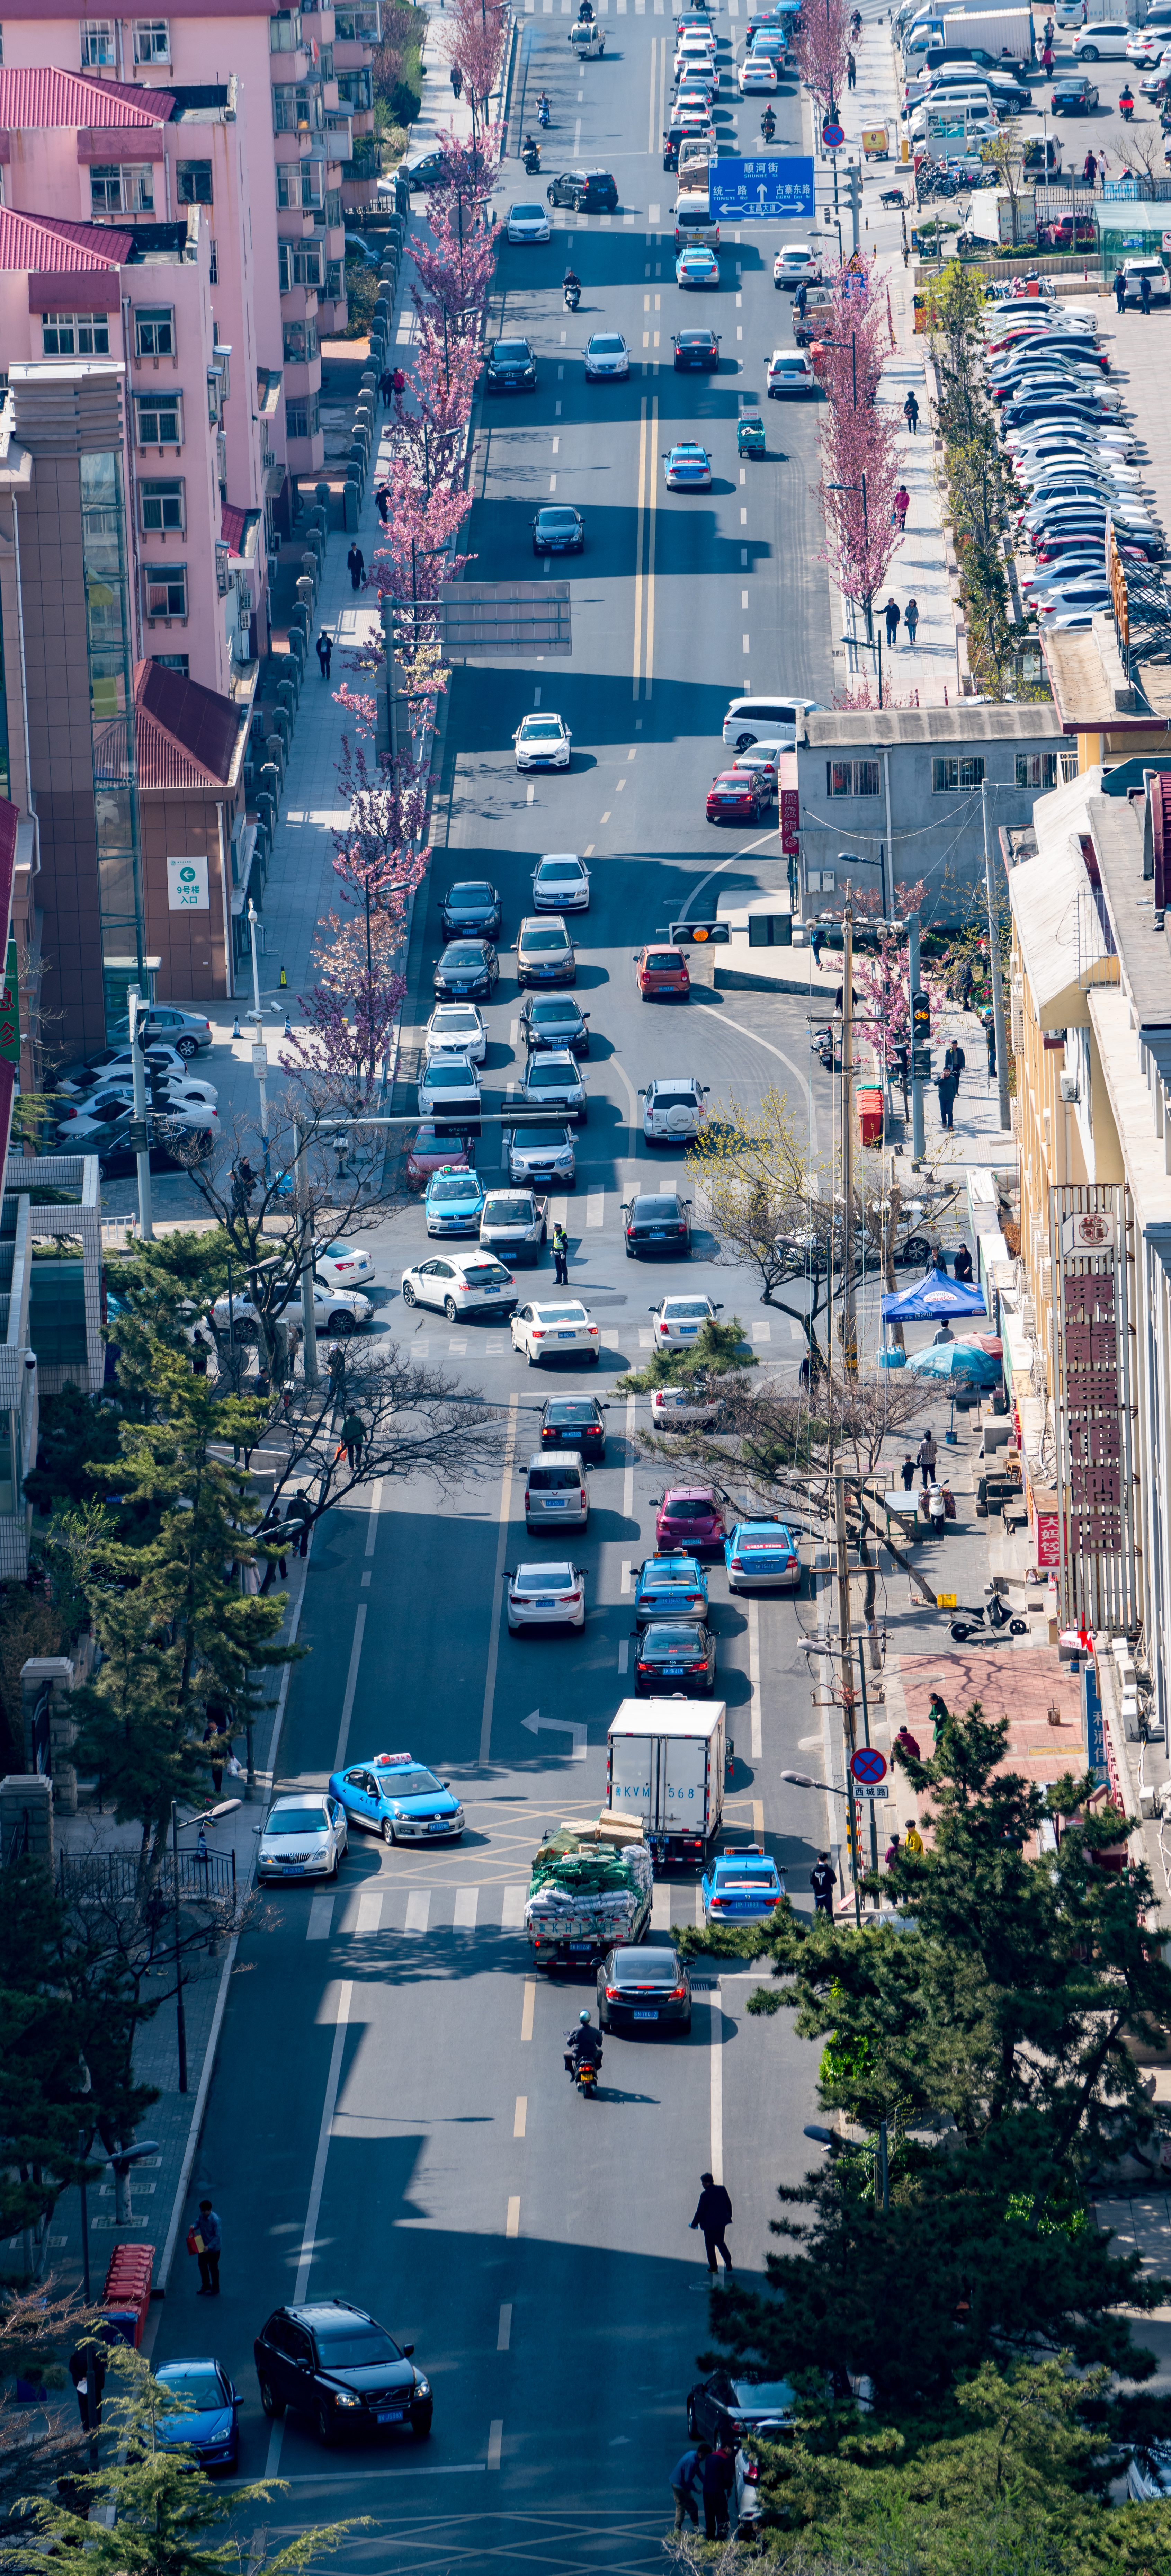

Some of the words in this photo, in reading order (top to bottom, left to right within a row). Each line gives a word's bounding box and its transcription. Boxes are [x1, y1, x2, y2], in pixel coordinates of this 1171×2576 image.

[744, 162, 778, 173] 顺河街
[713, 185, 747, 196] 统一路
[776, 184, 811, 195] 古寨东路
[749, 204, 776, 212] 世昌大道
[784, 793, 797, 848] 批发海参
[177, 885, 200, 894] 9号楼
[180, 895, 197, 904] 入口
[1040, 1517, 1060, 1565] 大妈饺子
[1092, 1693, 1109, 1781] 利浦伟康
[616, 1786, 650, 1797] 鲁KVM
[668, 1788, 694, 1798] 568
[855, 1787, 886, 1797] 西城路
[539, 1922, 616, 1934] 鲁KH123F
